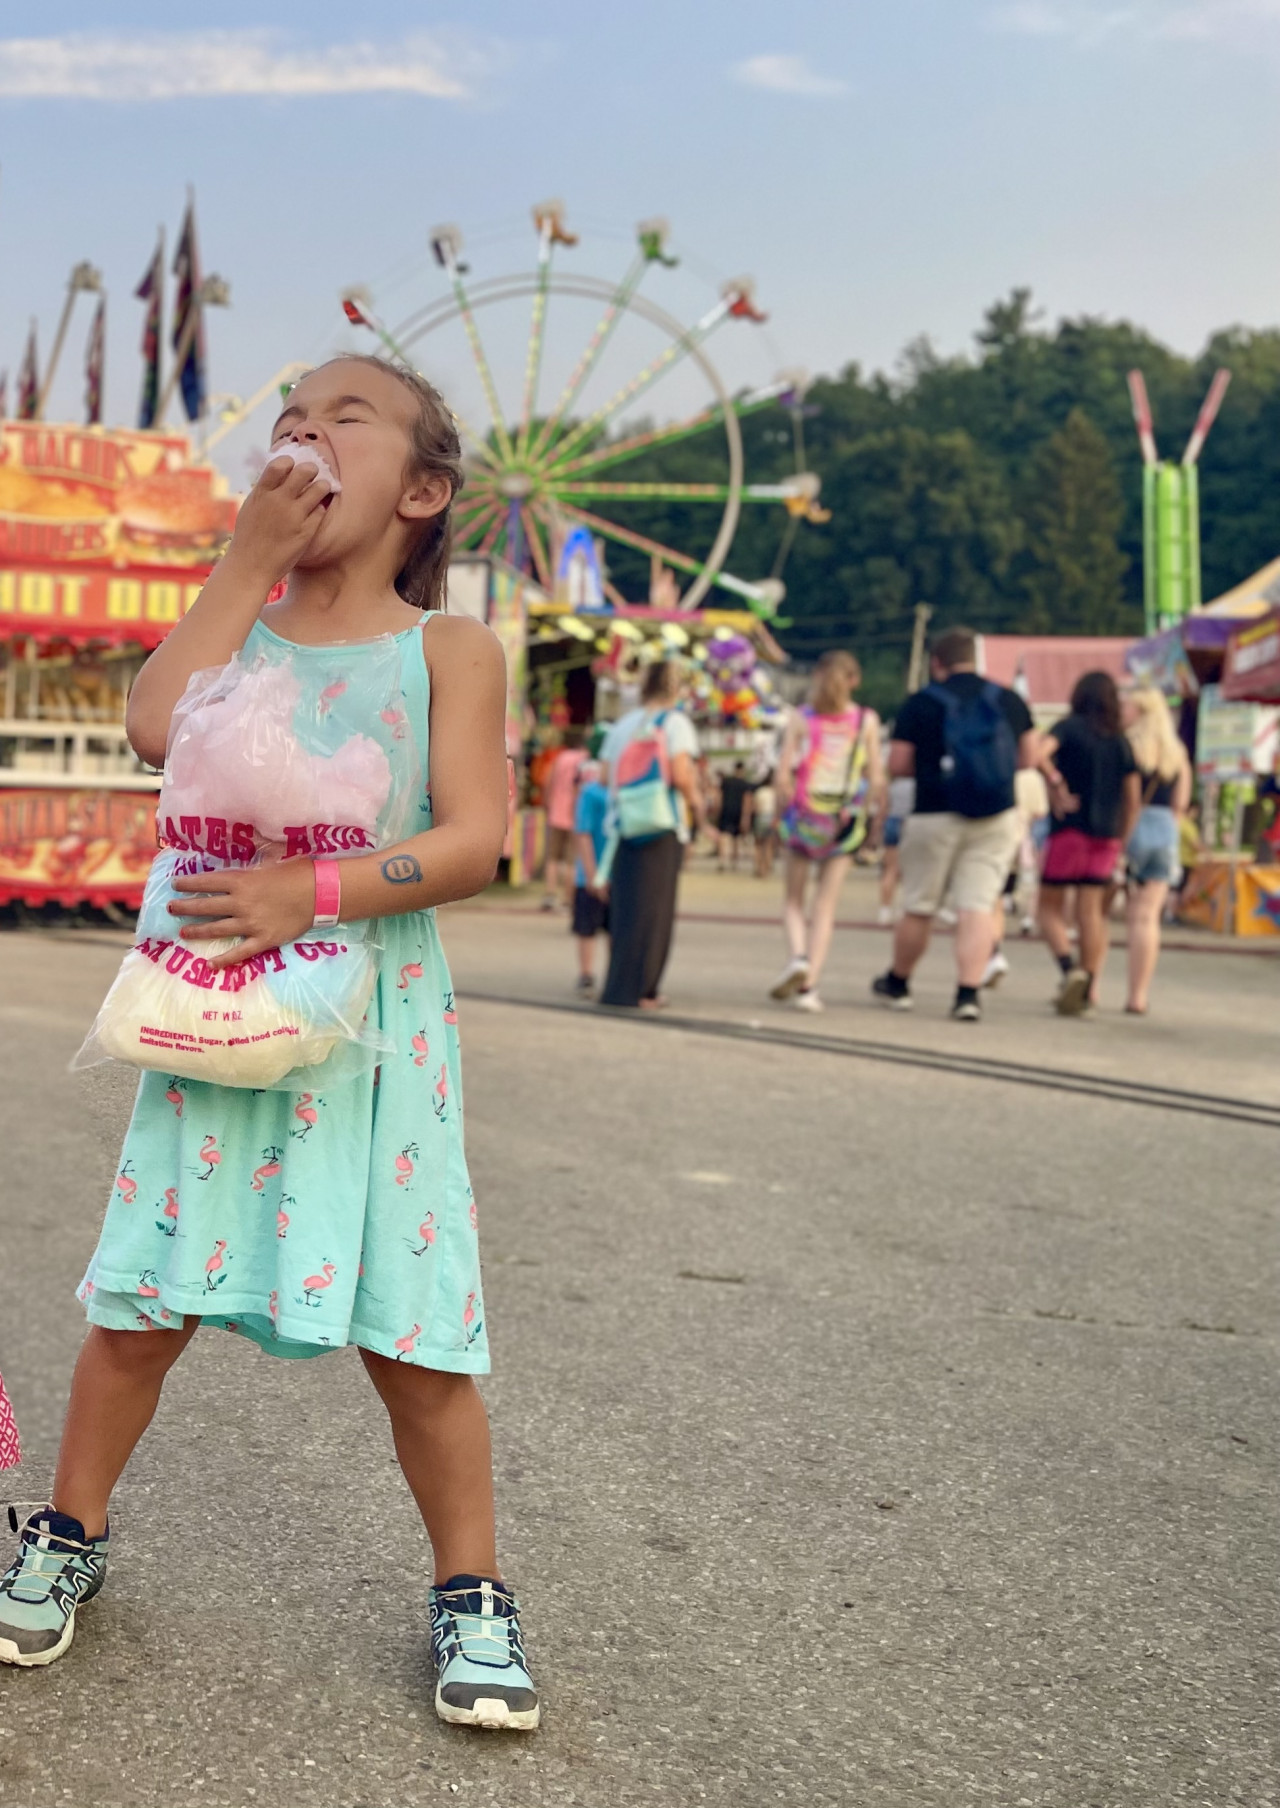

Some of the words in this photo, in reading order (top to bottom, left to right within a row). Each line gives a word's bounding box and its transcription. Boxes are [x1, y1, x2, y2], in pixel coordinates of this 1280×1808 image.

[107, 577, 202, 624] DO
[158, 815, 257, 867] ATES
[202, 1011, 218, 1021] NET
[140, 1026, 196, 1043] INGREDIENTS:
[198, 1036, 226, 1047] Sugar,
